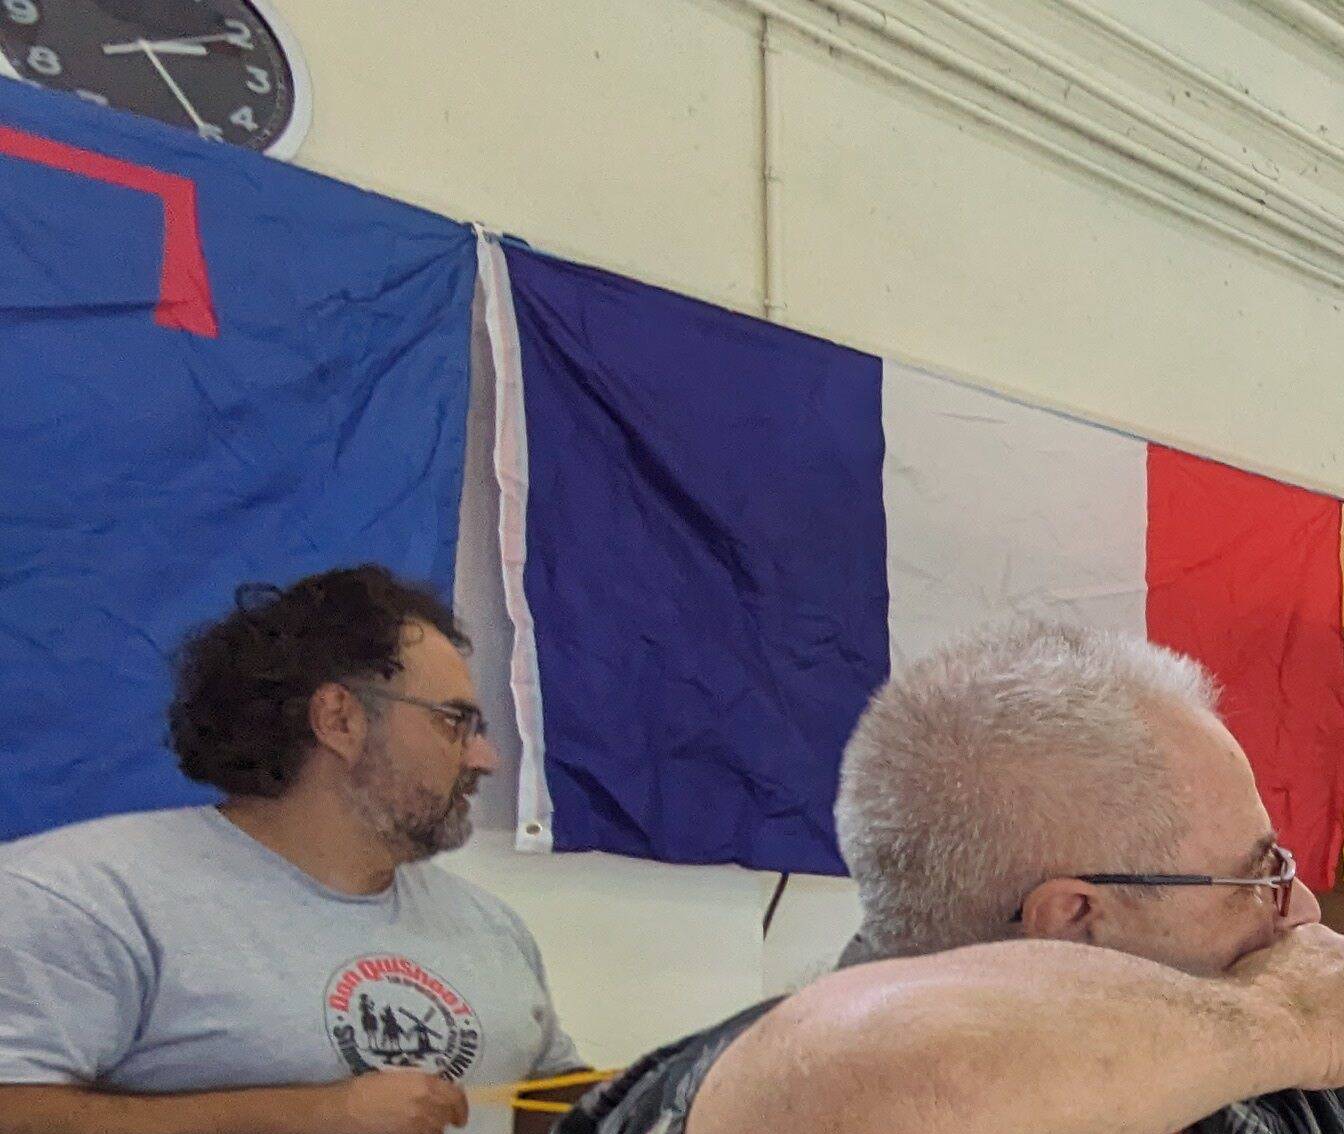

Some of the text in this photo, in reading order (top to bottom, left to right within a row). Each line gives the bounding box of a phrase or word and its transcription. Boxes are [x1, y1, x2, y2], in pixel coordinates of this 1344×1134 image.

[225, 19, 254, 50] 2
[27, 46, 62, 76] 8
[246, 64, 272, 94] 3
[229, 105, 259, 132] 4
